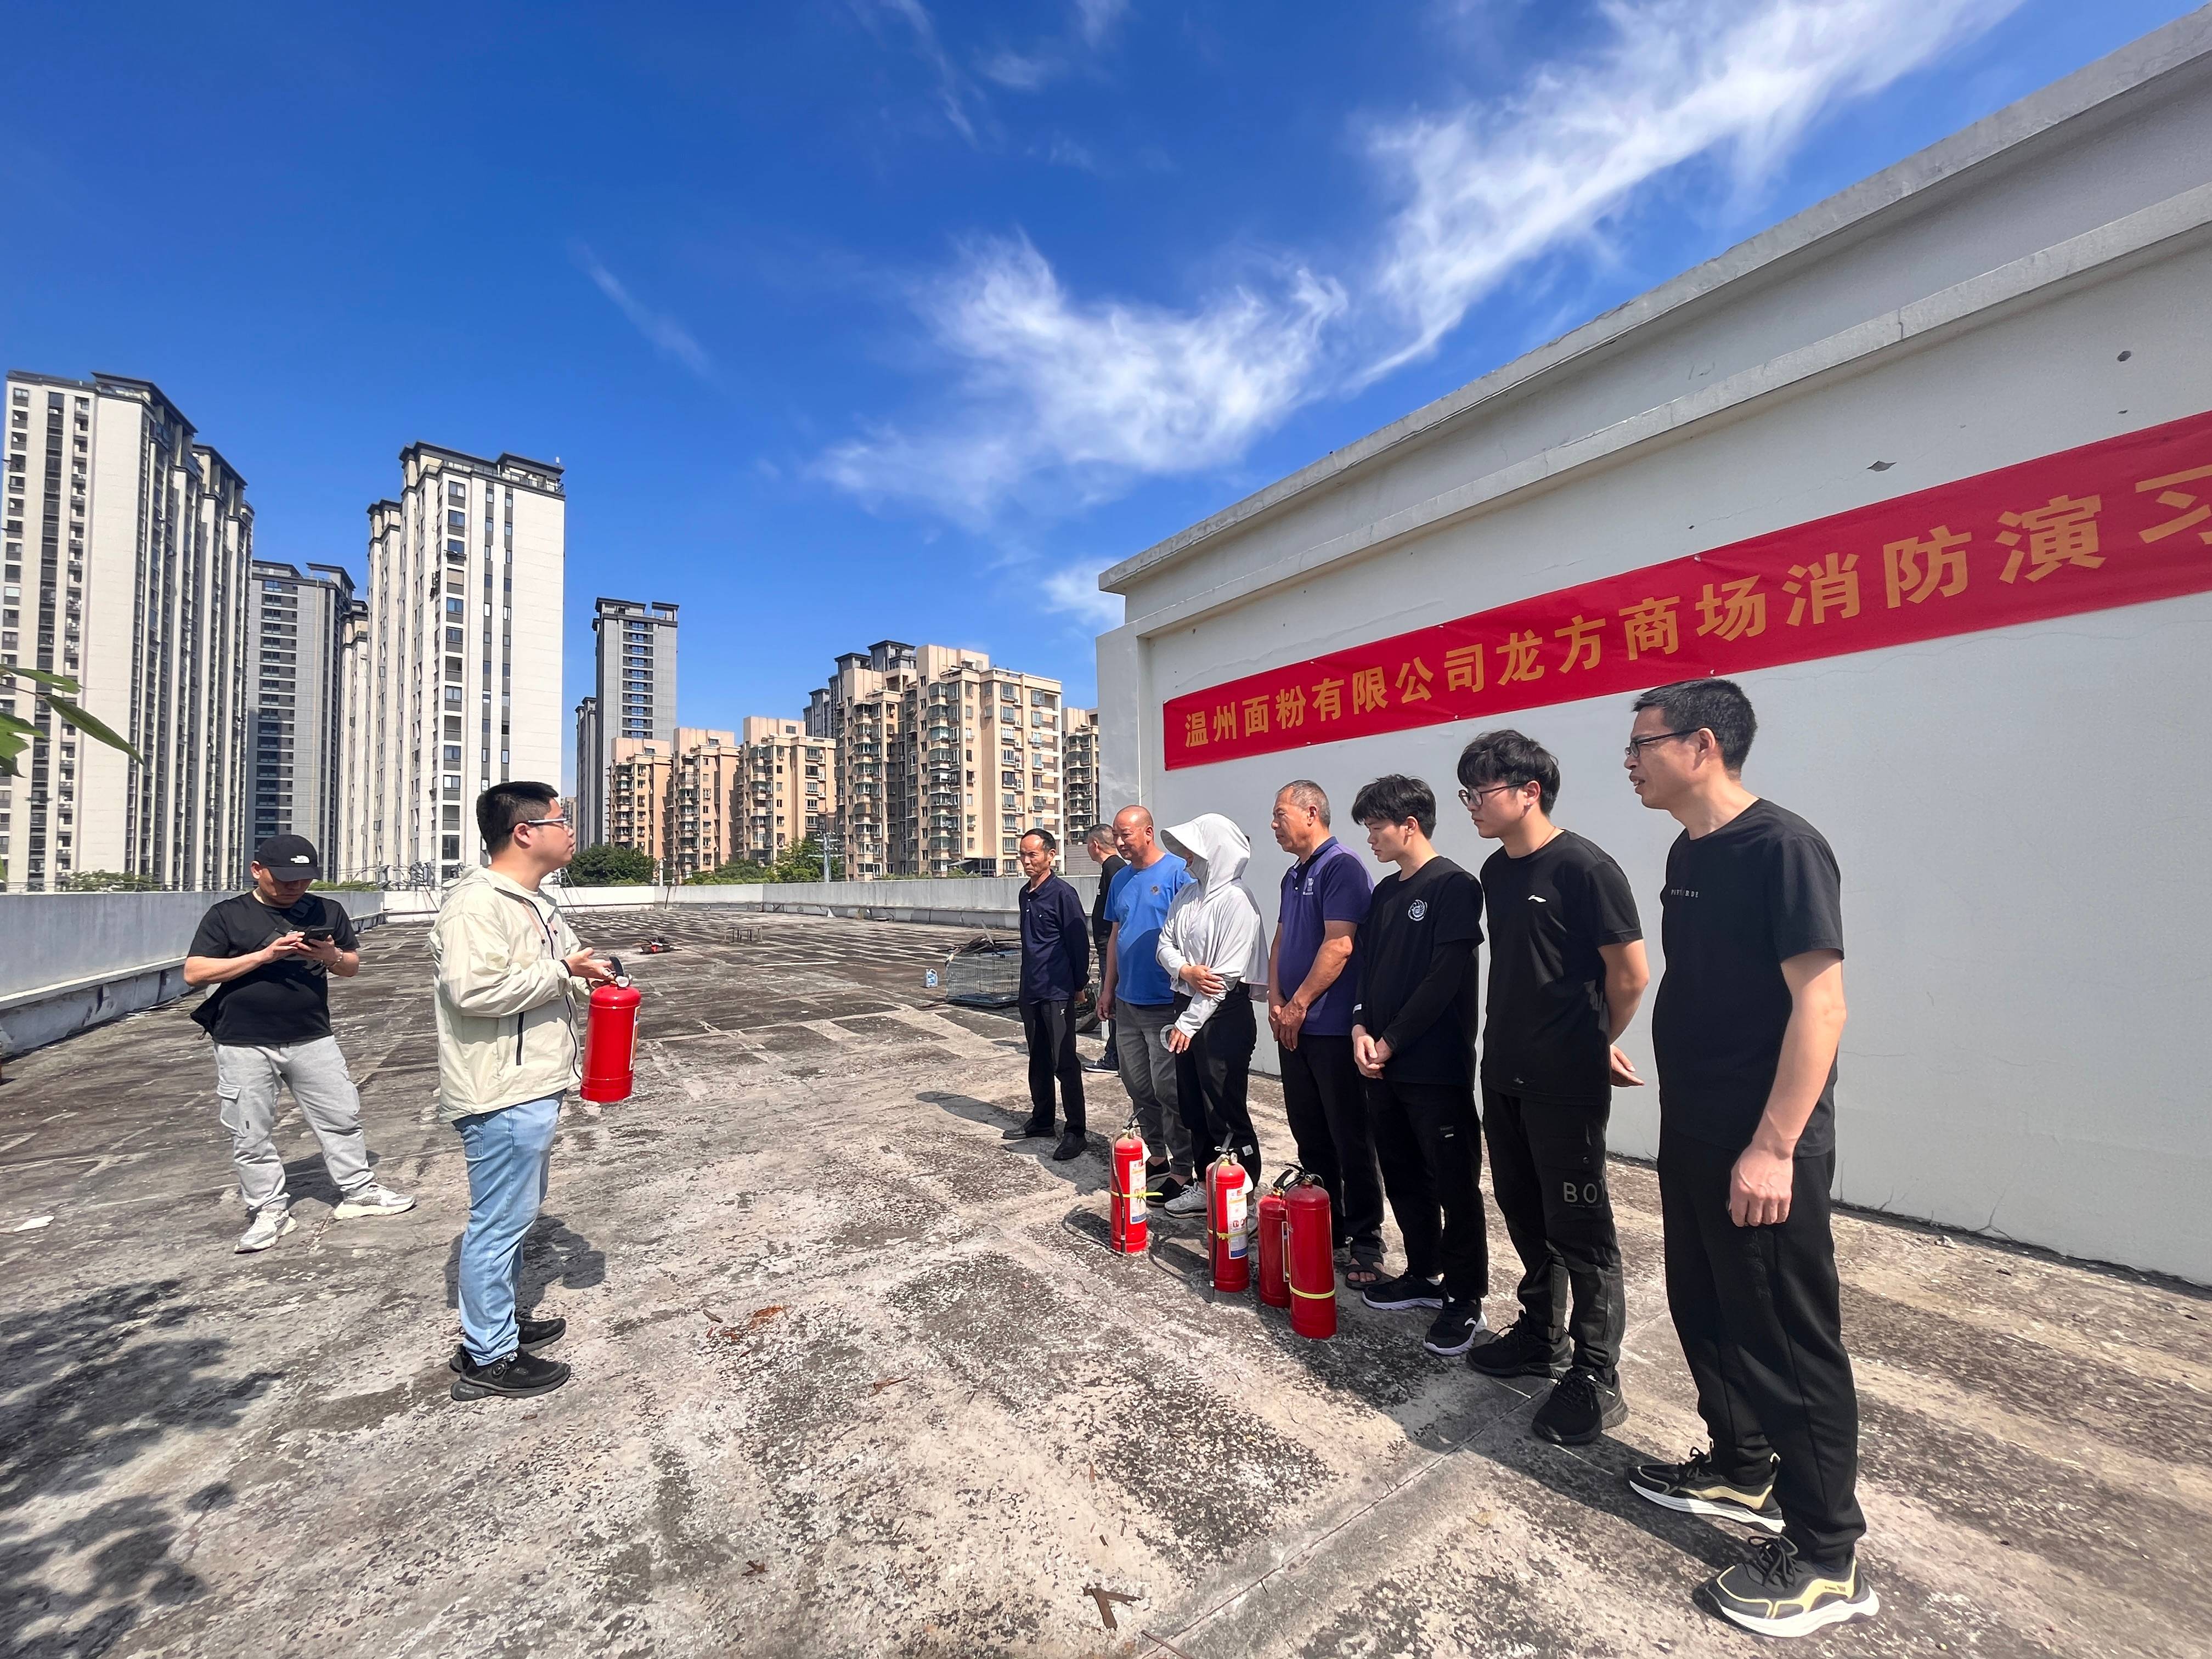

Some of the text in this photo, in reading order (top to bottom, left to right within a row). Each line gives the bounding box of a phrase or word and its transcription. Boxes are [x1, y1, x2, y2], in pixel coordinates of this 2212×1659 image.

[1184, 464, 2212, 748] 温州面粉有限公司龙方商场消防演习
